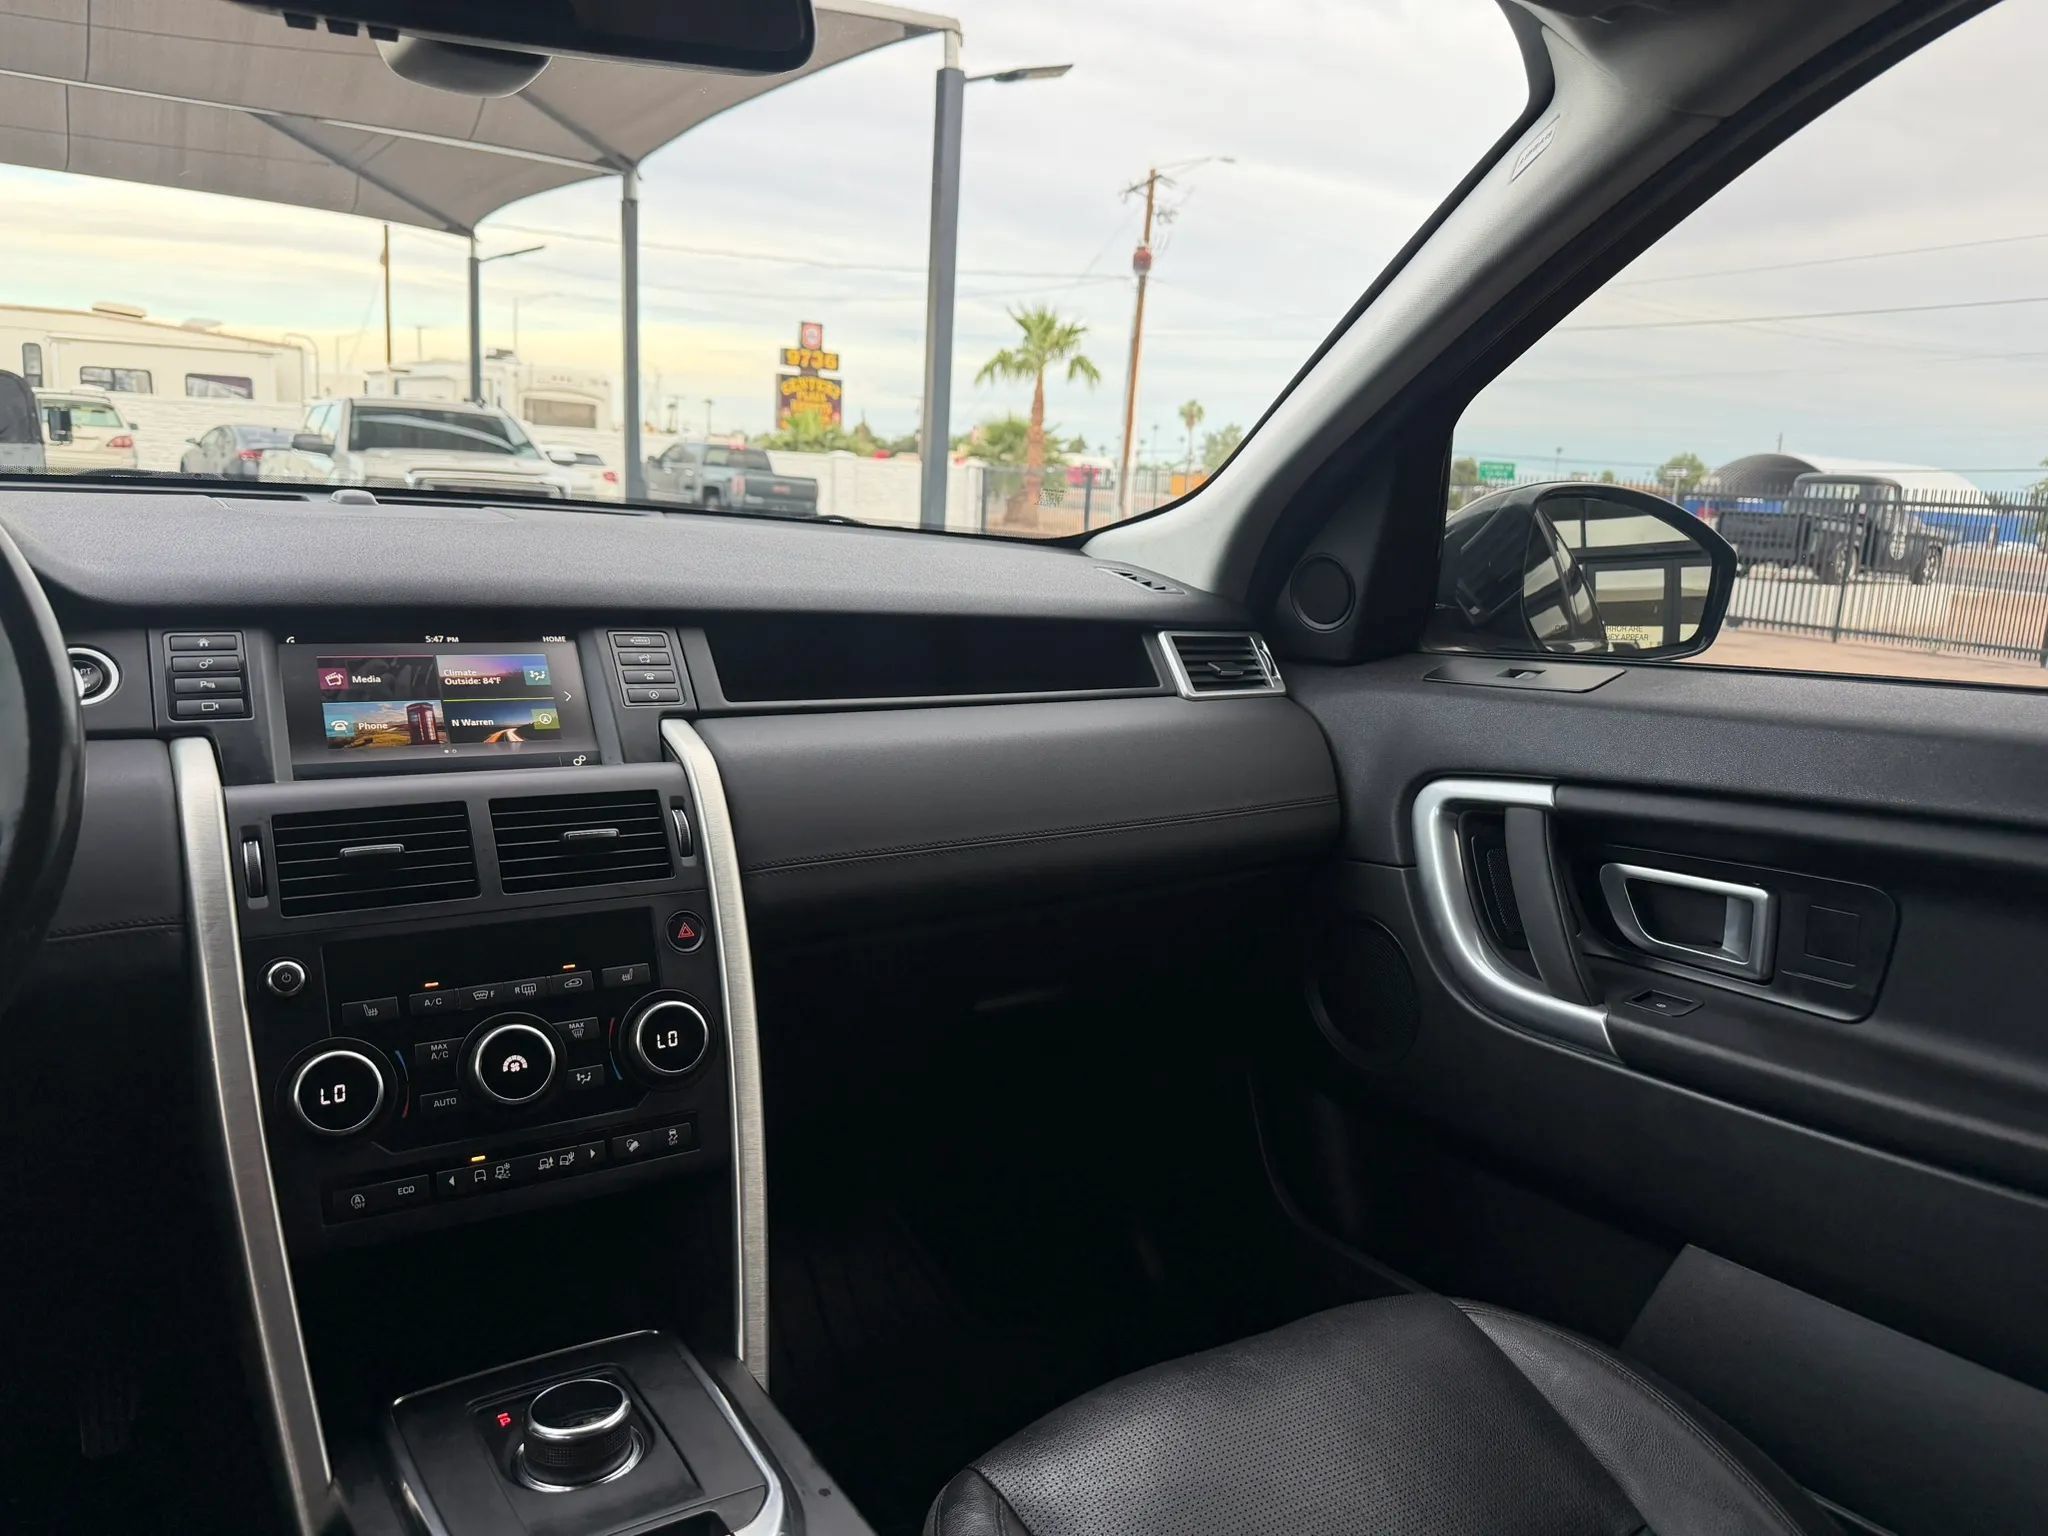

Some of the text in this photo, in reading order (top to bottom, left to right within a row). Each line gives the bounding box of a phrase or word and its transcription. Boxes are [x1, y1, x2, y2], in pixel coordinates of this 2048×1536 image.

[425, 635, 444, 643] 5:47
[542, 635, 567, 643] HOME
[443, 669, 477, 677] Climate
[352, 675, 382, 683] Media
[444, 677, 481, 686] Outside:
[358, 720, 389, 730] Phone
[452, 718, 494, 727] N Warren
[424, 997, 442, 1007] A/C
[430, 1043, 448, 1051] MAX
[431, 1050, 449, 1060] A/C
[433, 1097, 457, 1108] AUTO
[397, 1185, 415, 1196] ECO
